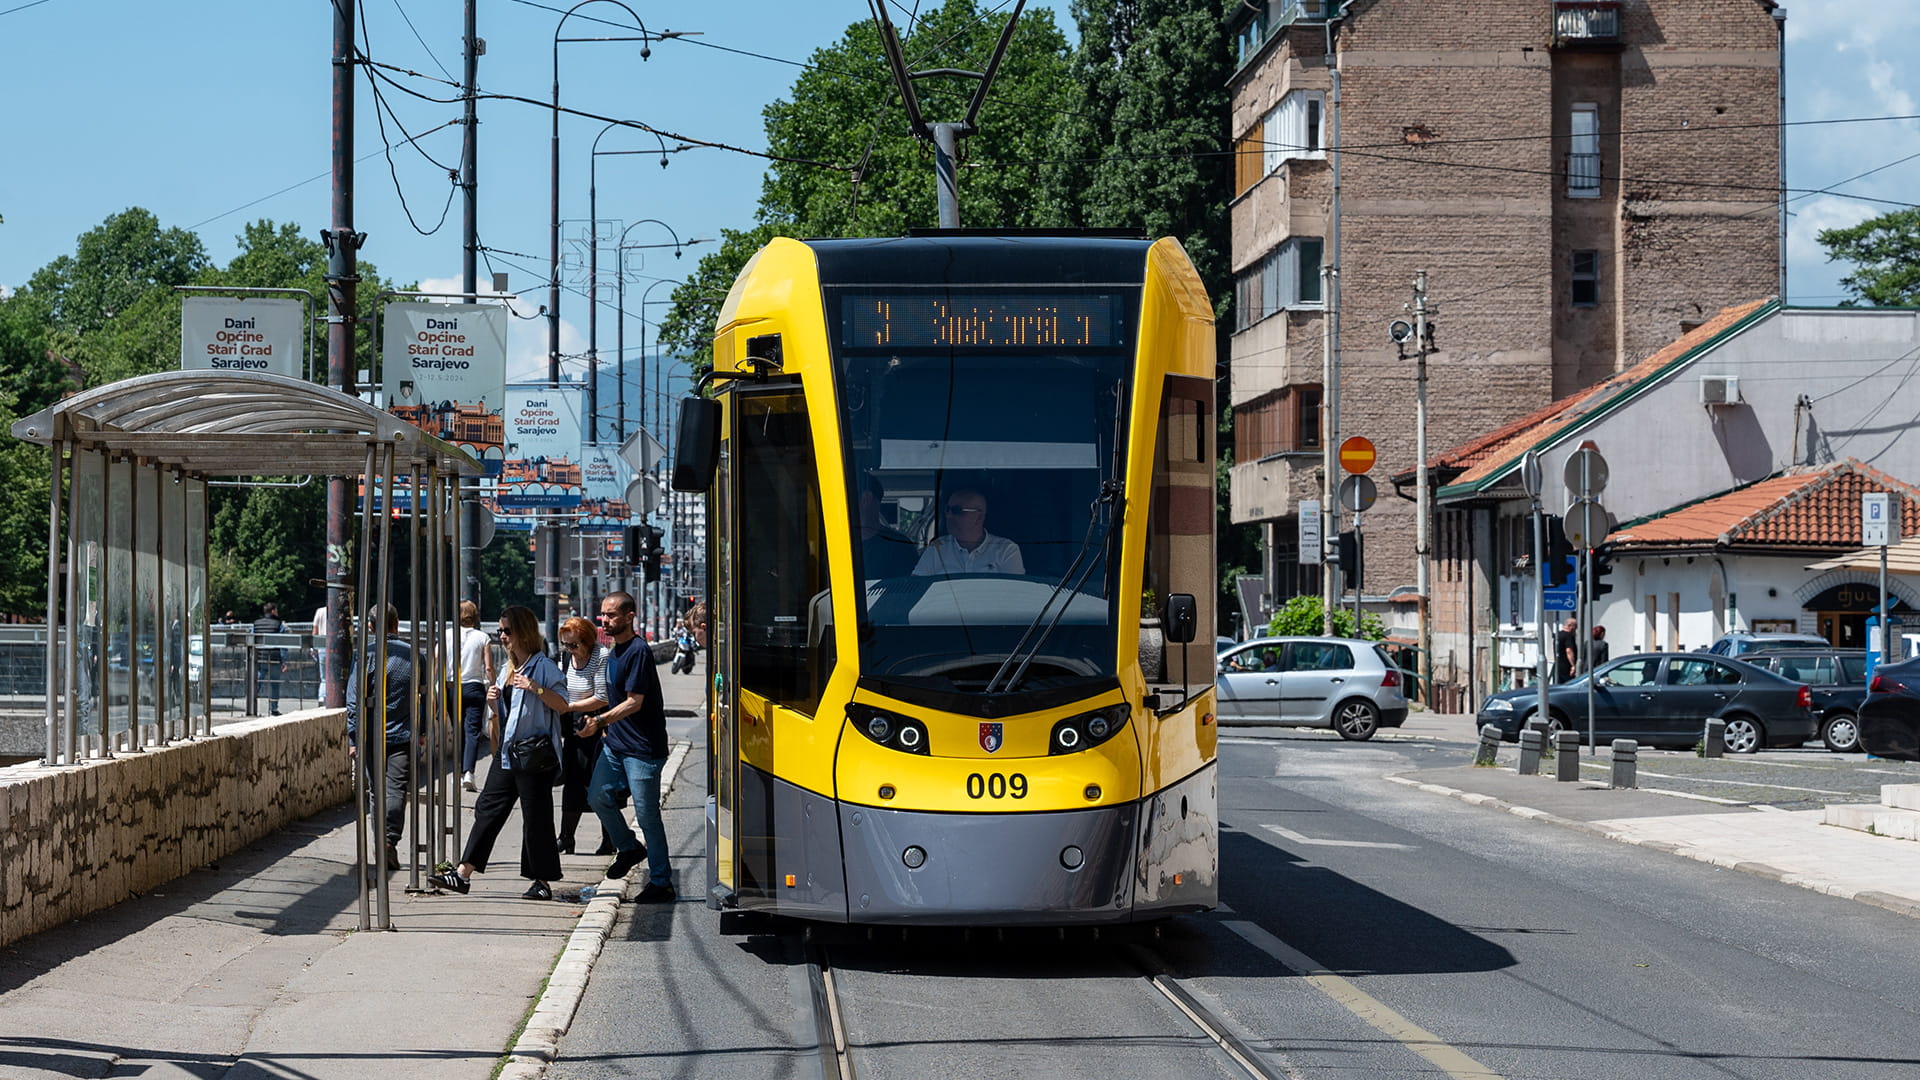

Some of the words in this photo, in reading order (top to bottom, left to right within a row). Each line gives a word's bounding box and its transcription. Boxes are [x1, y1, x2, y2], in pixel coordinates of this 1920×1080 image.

[225, 317, 255, 329] Dani
[426, 318, 458, 330] Dani
[216, 330, 264, 344] Općine
[417, 331, 466, 344] Općine
[207, 343, 237, 355] Stari
[240, 344, 272, 355] Grad
[408, 344, 439, 355] Stari
[442, 345, 474, 356] Grad
[211, 357, 268, 370] Sarajevo
[412, 357, 470, 371] Sarajevo
[526, 400, 548, 408] Dani
[514, 417, 536, 426] Stari
[537, 418, 560, 426] Grad
[517, 426, 557, 436] Sarajevo
[966, 772, 1028, 799] 009
